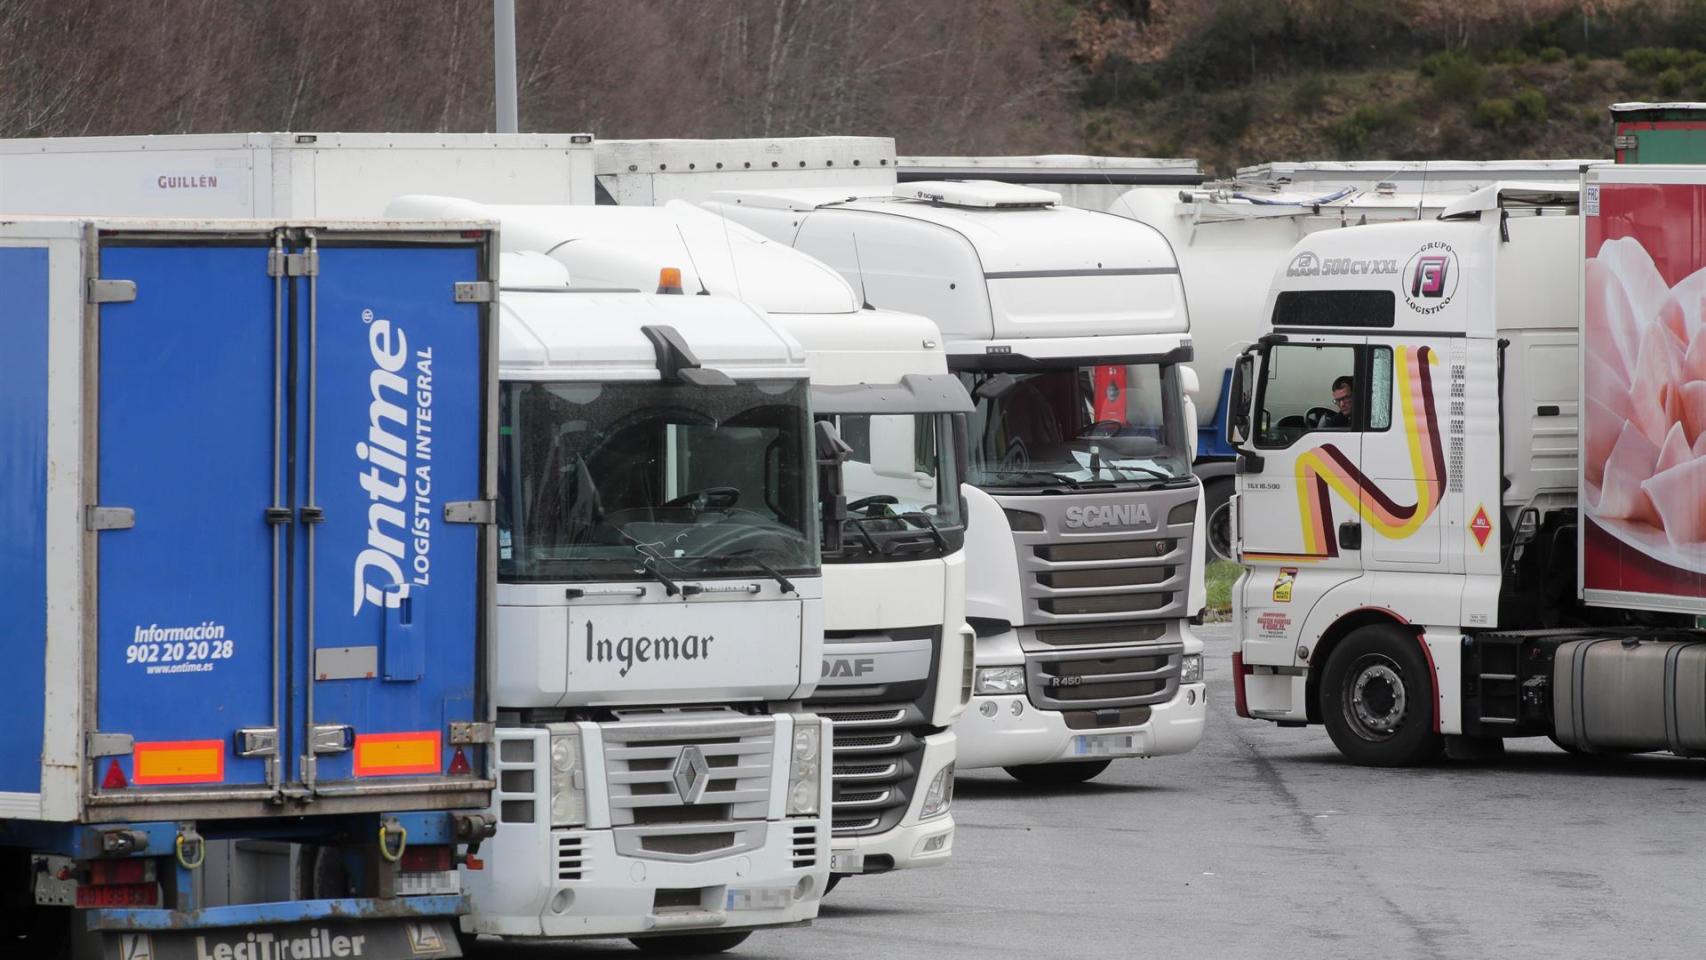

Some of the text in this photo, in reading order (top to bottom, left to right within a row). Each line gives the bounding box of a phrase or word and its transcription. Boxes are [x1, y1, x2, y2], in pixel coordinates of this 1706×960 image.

[1421, 241, 1452, 253] GRUPO
[1371, 259, 1399, 274] XXL
[1406, 296, 1451, 315] LOGISTICO
[411, 346, 433, 586] LOGÍSTICA INTEGRAL
[1065, 503, 1152, 529] SCANIA
[134, 621, 225, 643] Información
[126, 640, 234, 664] 902 20 20 28
[586, 619, 714, 678] Ingemar
[146, 662, 214, 674] www.ontime.es
[1053, 675, 1081, 687] R 450
[196, 928, 366, 960] LeciTrailer
